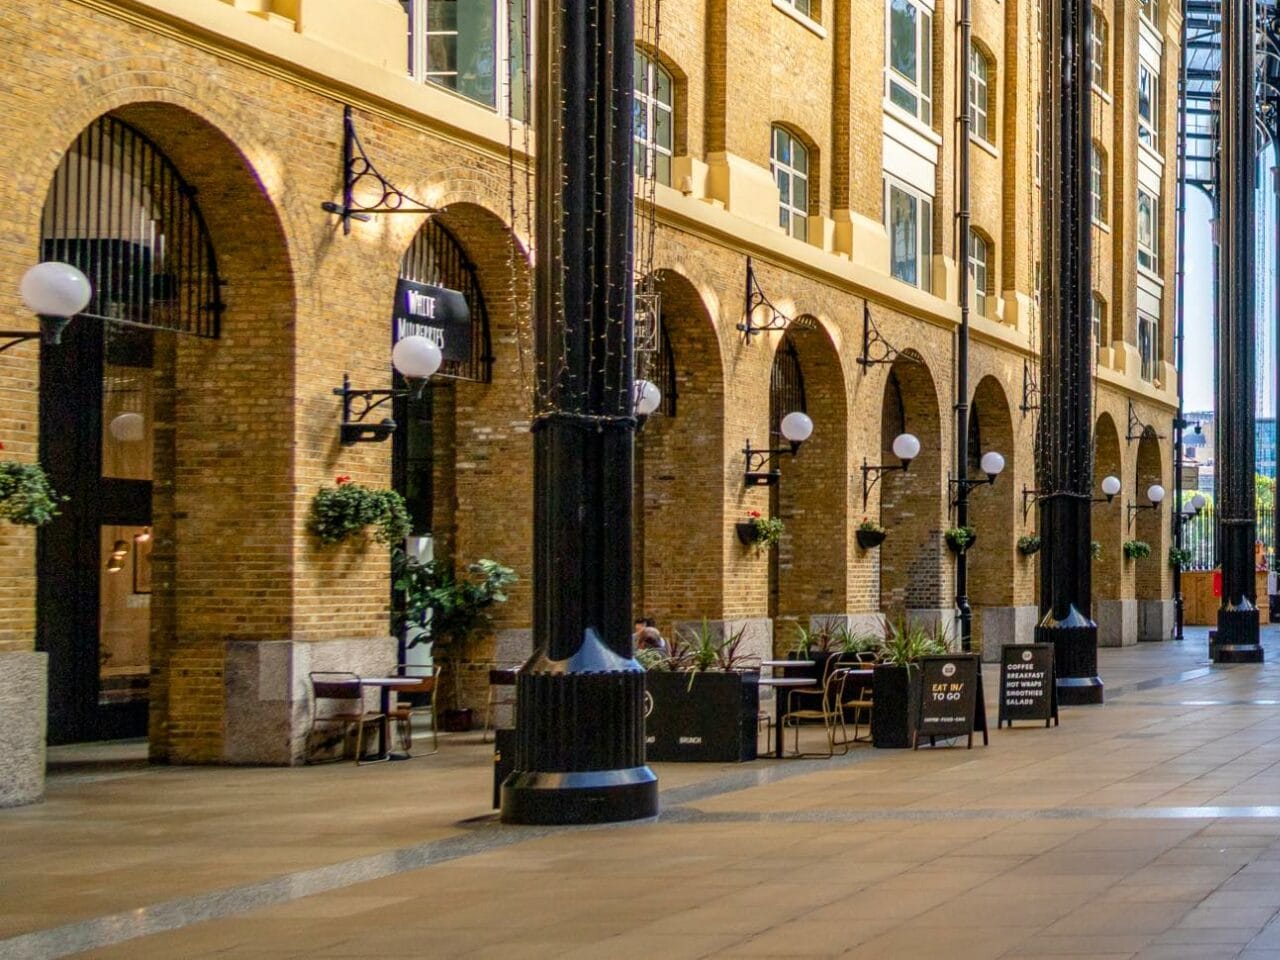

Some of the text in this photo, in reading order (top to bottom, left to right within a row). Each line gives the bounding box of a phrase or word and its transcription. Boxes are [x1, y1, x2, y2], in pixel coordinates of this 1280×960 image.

[932, 683, 948, 692] EAT
[932, 692, 961, 701] TO GO
